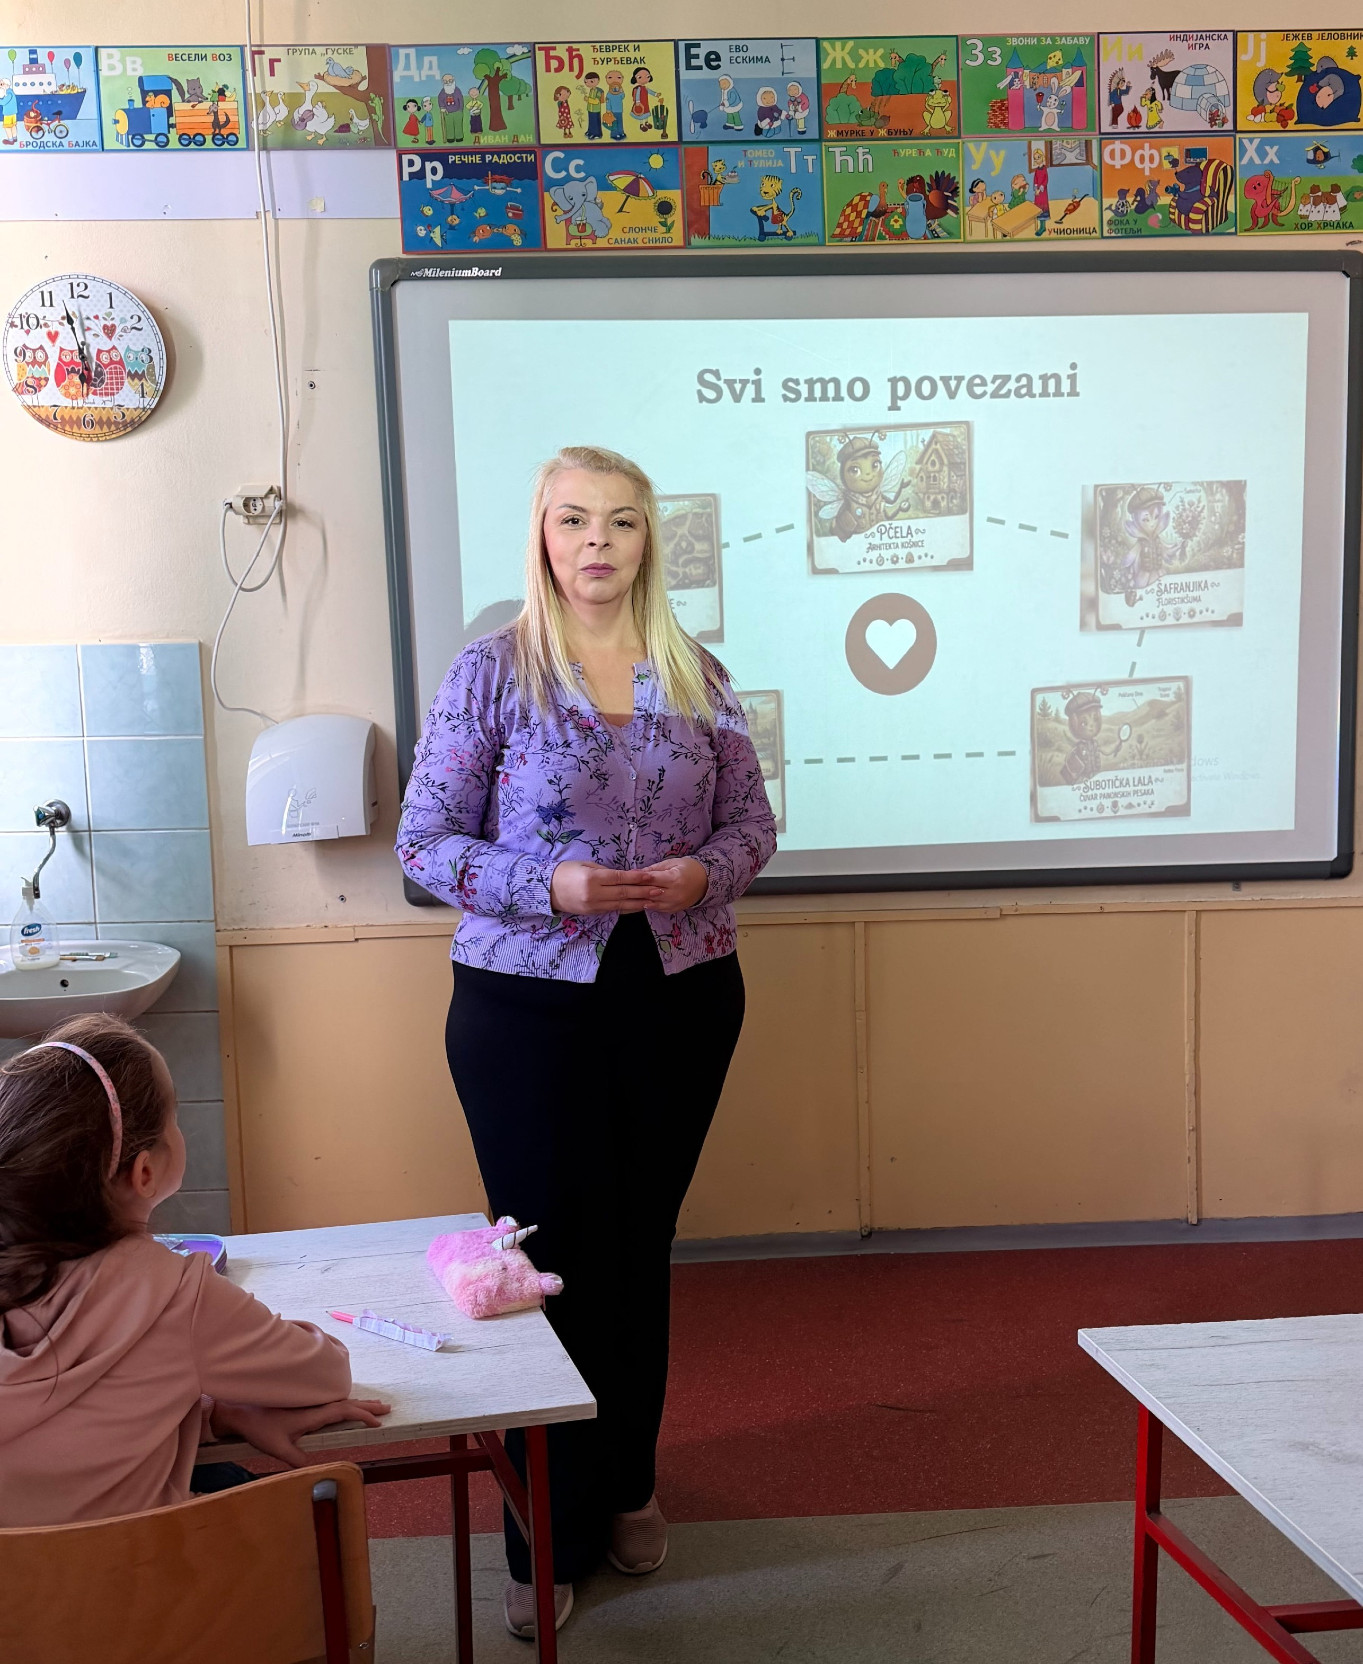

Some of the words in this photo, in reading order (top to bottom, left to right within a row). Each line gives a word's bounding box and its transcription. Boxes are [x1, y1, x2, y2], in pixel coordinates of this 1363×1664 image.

[1006, 37, 1038, 46] ЗВОНИ
[1040, 37, 1053, 45] ЗА
[1055, 36, 1090, 45] ЗАБАВУ
[1169, 33, 1229, 43] ИНДИЈАНСКА
[1281, 33, 1313, 42] ЈЕЖЕВ
[591, 44, 630, 53] ЂЕВРЕК
[633, 44, 641, 53] И
[729, 44, 749, 53] ЕВО
[1187, 42, 1210, 51] ИГРА
[287, 48, 317, 56] ГРУПА
[167, 53, 208, 62] ВЕСЕЛИ
[211, 53, 233, 62] ВОЗ
[592, 56, 646, 66] ЂУРЂЕВАК
[729, 55, 771, 64] ЕСКИМА
[827, 129, 866, 138] ЖМУРКЕ
[869, 129, 875, 137] У
[878, 128, 914, 137] ЖБУЊУ
[19, 140, 64, 149] БРОДСКА
[68, 140, 98, 148] БАЈКА
[473, 135, 509, 146] ДИВАН
[512, 134, 533, 144] ДАН
[742, 149, 775, 158] ТОМЕО
[892, 148, 932, 157] ЋУРЕЋА
[935, 148, 956, 158] ЋУД
[448, 155, 482, 164] РЕЧНЕ
[485, 154, 535, 164] РАДОСТИ
[747, 160, 784, 168] ТУЛИЈА
[1107, 219, 1131, 227] ФОКА
[1133, 218, 1138, 226] У
[1294, 222, 1313, 231] ХОР
[1316, 221, 1354, 230] ХРЧАКА
[621, 226, 659, 234] СЛОНЧЕ
[1048, 227, 1098, 236] УЧИОНИЦА
[1107, 227, 1142, 236] ФОТЕЉИ
[607, 237, 639, 245] САНАК
[642, 236, 674, 244] СНИЛО
[68, 281, 90, 300] 12
[39, 290, 55, 308] 11
[107, 291, 115, 310] 1
[18, 312, 40, 331] 10
[130, 314, 144, 332] 2
[13, 346, 27, 363] 9
[23, 379, 38, 396] 8
[696, 367, 766, 404] Svi
[781, 375, 871, 403] smo
[888, 362, 1081, 412] povezani
[50, 404, 61, 423] 7
[113, 404, 126, 421] 5
[82, 413, 96, 430] 6
[876, 522, 914, 541] PČELA
[1082, 775, 1131, 793] SUBOTIČKA
[1132, 774, 1153, 787] LALA
[23, 926, 40, 934] fresh
